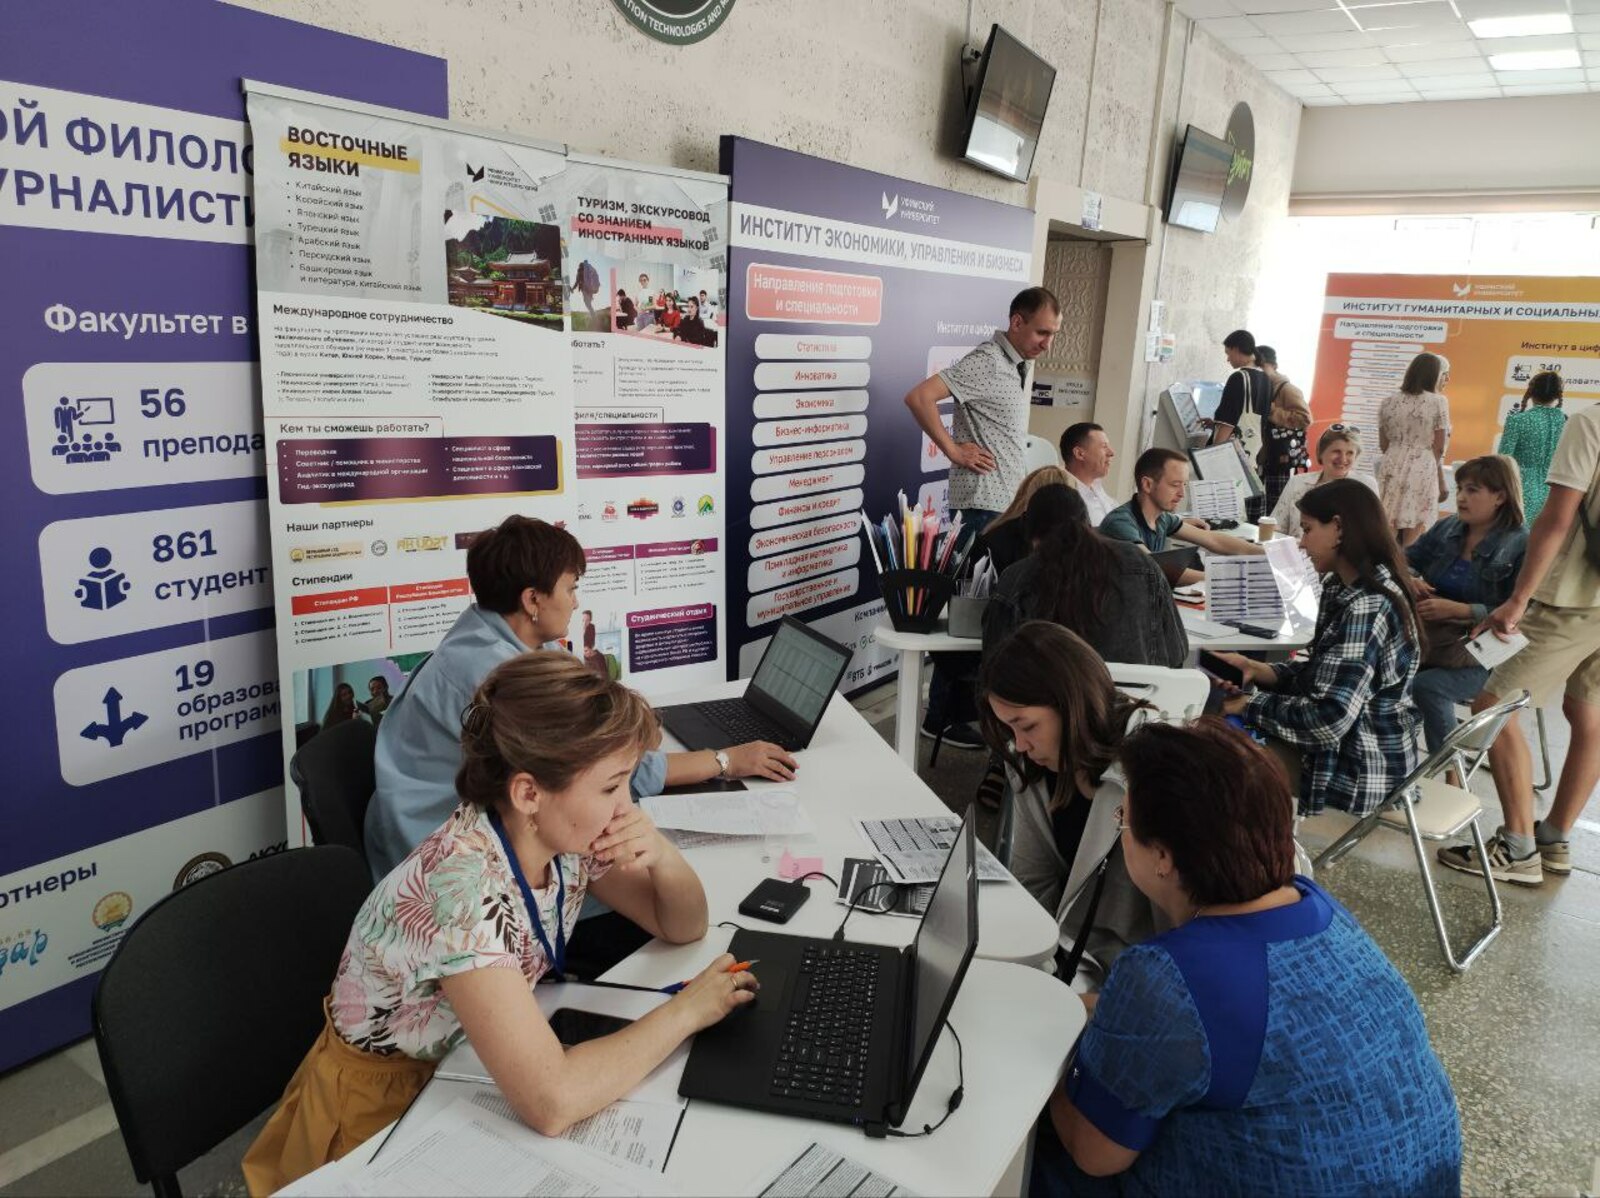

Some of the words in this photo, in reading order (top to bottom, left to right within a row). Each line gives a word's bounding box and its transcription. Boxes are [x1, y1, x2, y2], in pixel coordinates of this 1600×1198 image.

[648, 16, 707, 37] TECHNOLOGIES
[707, 4, 721, 26] AND
[287, 126, 408, 161] ВОСТОЧНЫЕ
[288, 152, 360, 177] ЯЗЫКИ
[295, 182, 342, 197] Китайский
[295, 195, 343, 209] Корейский
[577, 196, 628, 214] ТУРИЗМ,
[631, 203, 711, 224] ЭКСКУРСОВОД
[297, 208, 339, 221] Японский
[578, 212, 594, 224] СО
[597, 214, 652, 230] ЗНАНИЕМ
[297, 222, 338, 233] Турецкий
[298, 236, 340, 248] Арабский
[578, 228, 664, 246] ИНОСТРАННЫХ
[666, 237, 710, 251] ЯЗЫКОВ
[740, 213, 822, 246] ИНСТИТУТ
[825, 228, 908, 258] ЭКОНОМИКИ,
[910, 242, 976, 267] УПРАВЛЕНИЯ
[976, 252, 985, 267] И
[985, 253, 1024, 273] БИЗНЕСА
[299, 250, 351, 262] Персидский
[754, 272, 824, 294] Направления
[826, 282, 877, 299] подготовки
[273, 304, 367, 319] Международное
[369, 311, 454, 325] сотрудничество
[775, 299, 783, 311] и
[785, 300, 859, 316] специальности
[1343, 302, 1402, 312] ИНСТИТУТ
[1404, 303, 1501, 316] ГУМАНИТАРНЫХ
[1504, 307, 1513, 316] И
[1515, 307, 1600, 318] СОЦИАЛЬНЫ
[44, 303, 223, 339] Факультет
[232, 315, 249, 335] в
[1340, 321, 1394, 329] Направления
[1395, 323, 1443, 331] подготовки
[1361, 331, 1424, 339] специальности
[571, 340, 605, 349] ботать?
[1521, 341, 1569, 352] Институт
[794, 370, 837, 381] Инноватика
[140, 388, 186, 418] 56
[795, 398, 835, 409] Экономика
[280, 424, 303, 433] Кем
[307, 424, 321, 433] ты
[324, 424, 373, 433] сможешь
[376, 422, 429, 434] работать?
[775, 422, 850, 437] Бизнес-информатика
[143, 434, 265, 462] препода
[295, 449, 337, 458] Переводчик
[769, 452, 812, 464] Управление
[297, 471, 331, 479] Аналитик
[337, 469, 390, 477] международной
[788, 475, 834, 488] Менеджмент
[287, 521, 319, 533] Наши
[321, 518, 374, 531] партнеры
[153, 529, 217, 562] 861
[755, 531, 812, 550] Экономическая
[155, 567, 268, 600] студент
[291, 572, 353, 587] Стипендии
[631, 611, 684, 623] Студенческий
[685, 607, 708, 617] отдых
[756, 598, 813, 619] муниципальное
[175, 660, 215, 692] 19
[179, 702, 282, 741] програм
